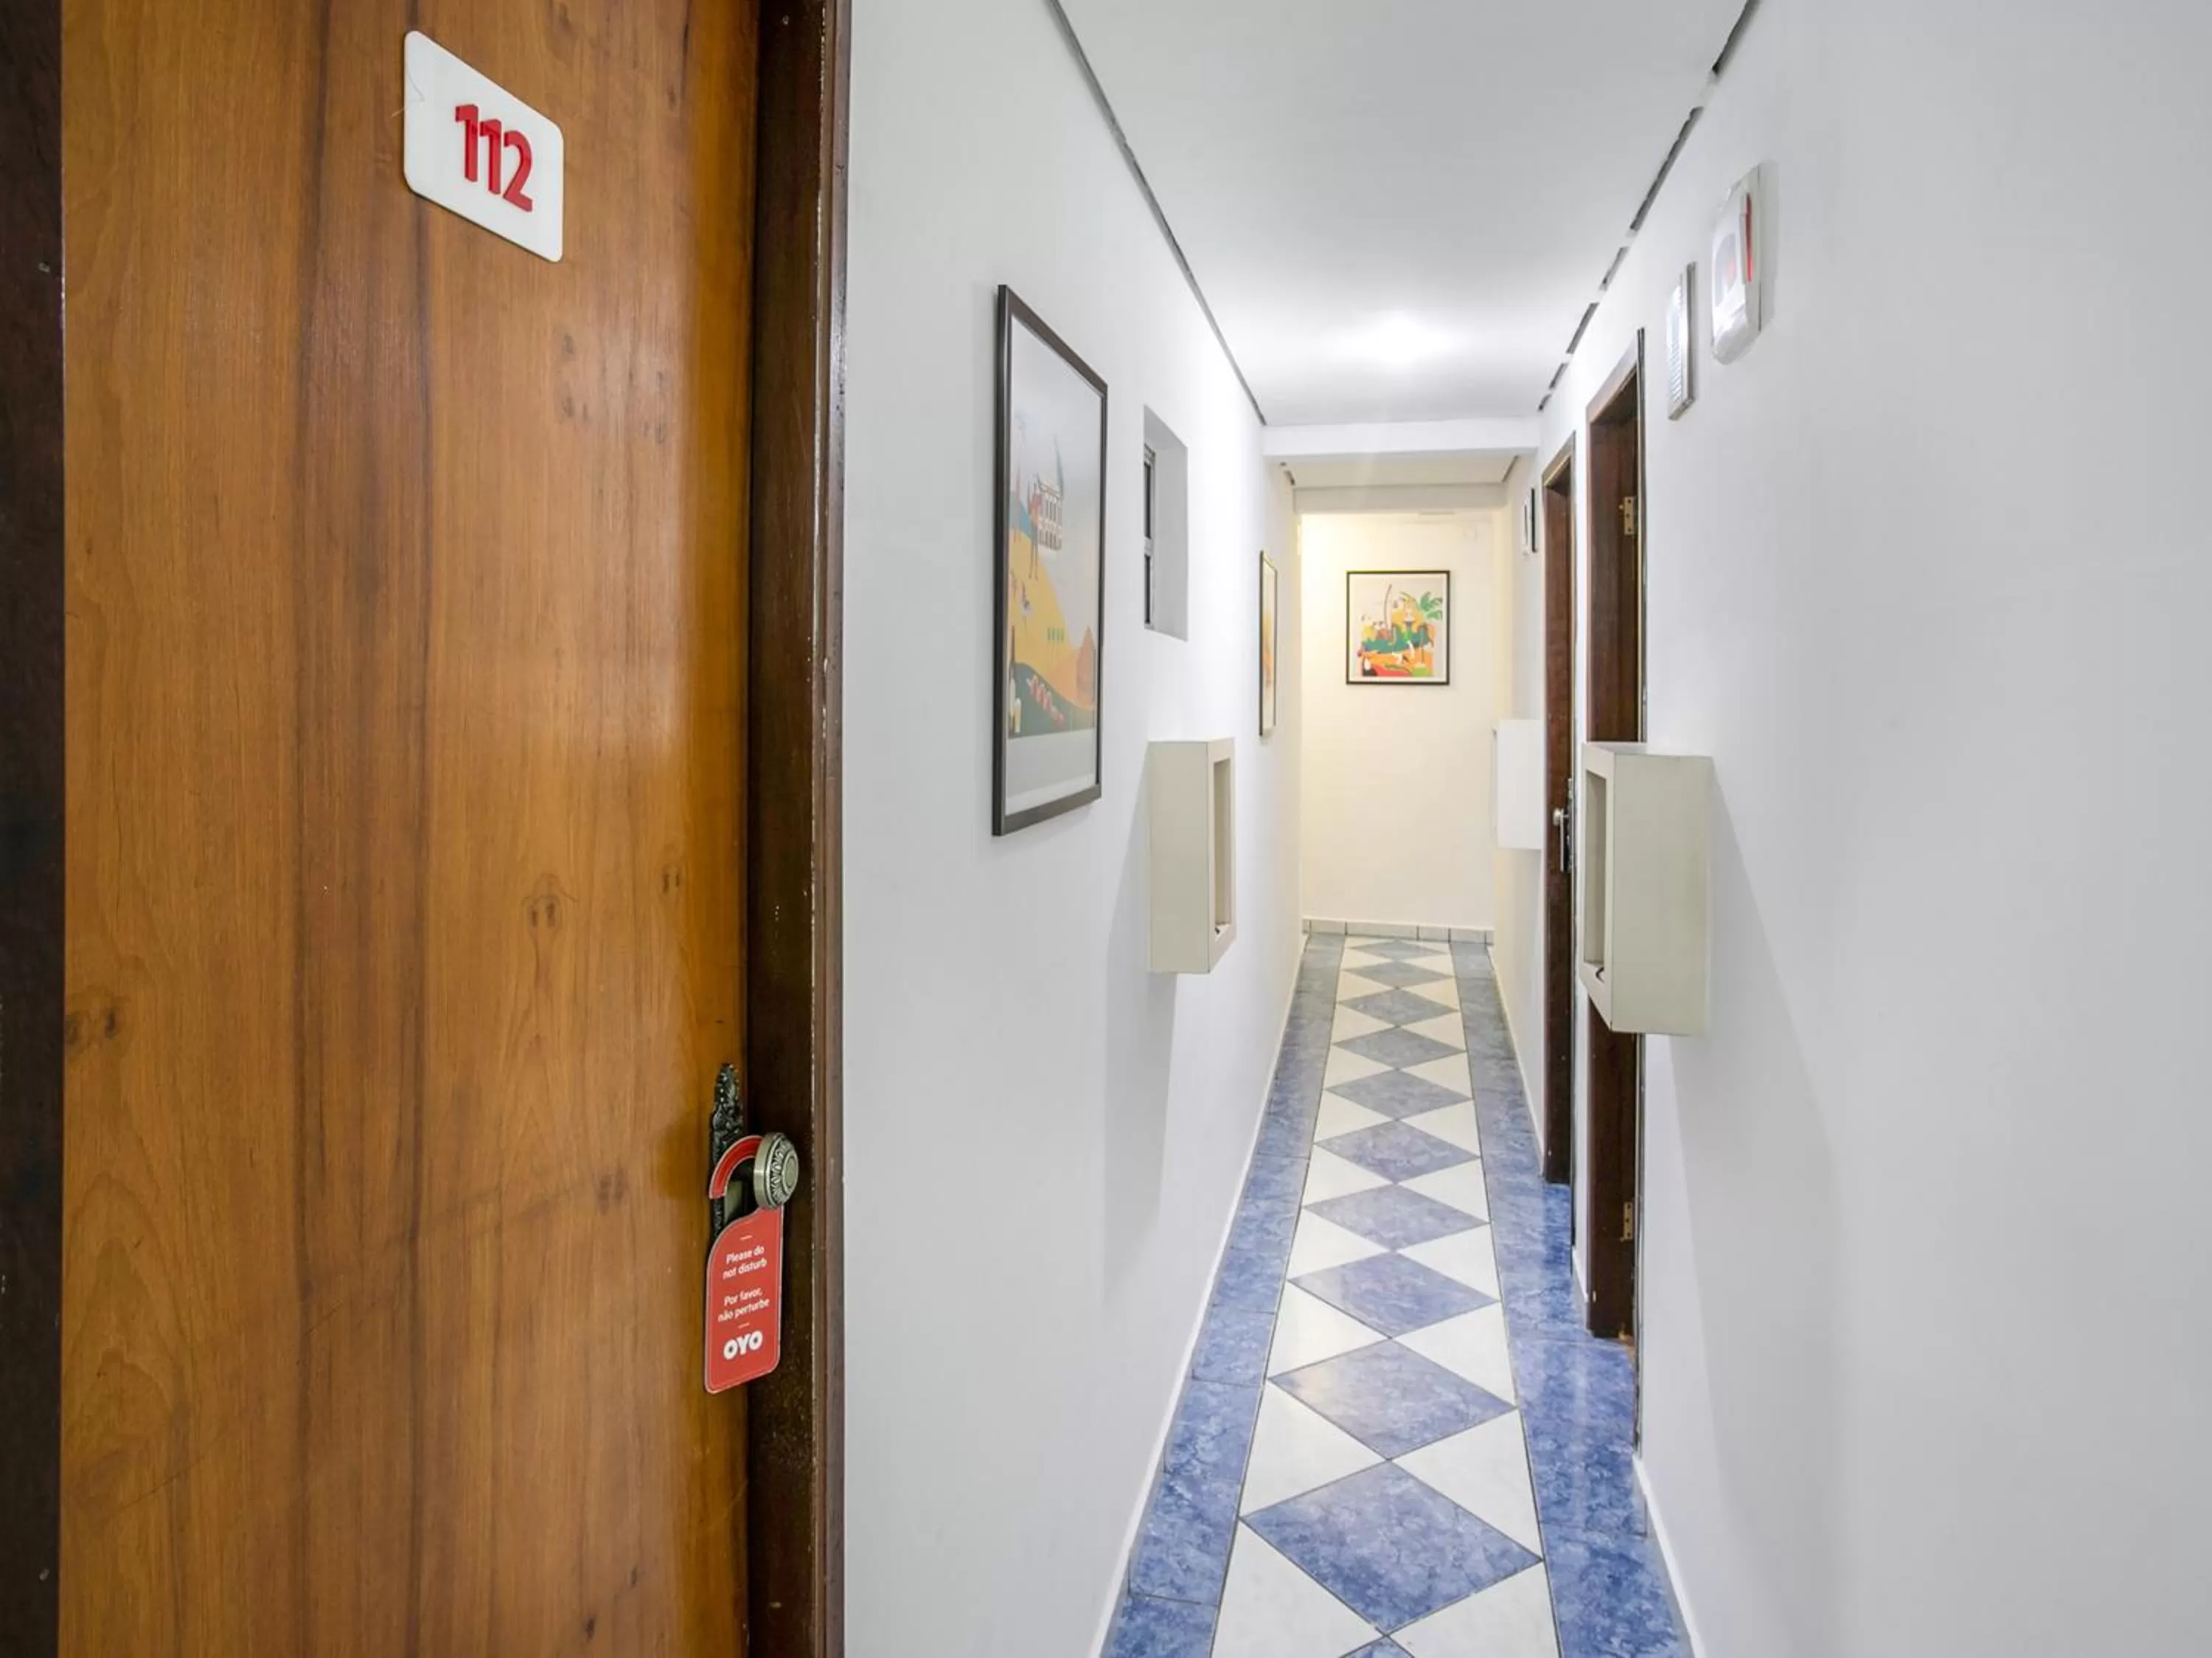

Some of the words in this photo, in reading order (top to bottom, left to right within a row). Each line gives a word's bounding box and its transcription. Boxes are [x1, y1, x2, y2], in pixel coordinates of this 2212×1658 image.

[455, 104, 532, 212] 112
[726, 1250, 752, 1265] Please
[754, 1245, 765, 1256] do
[723, 1267, 737, 1280] not
[738, 1258, 768, 1274] disturb
[724, 1295, 738, 1306] Por
[740, 1287, 762, 1301] favor,
[717, 1309, 734, 1322] não
[734, 1298, 770, 1319] perturbe
[723, 1330, 763, 1361] OYO
